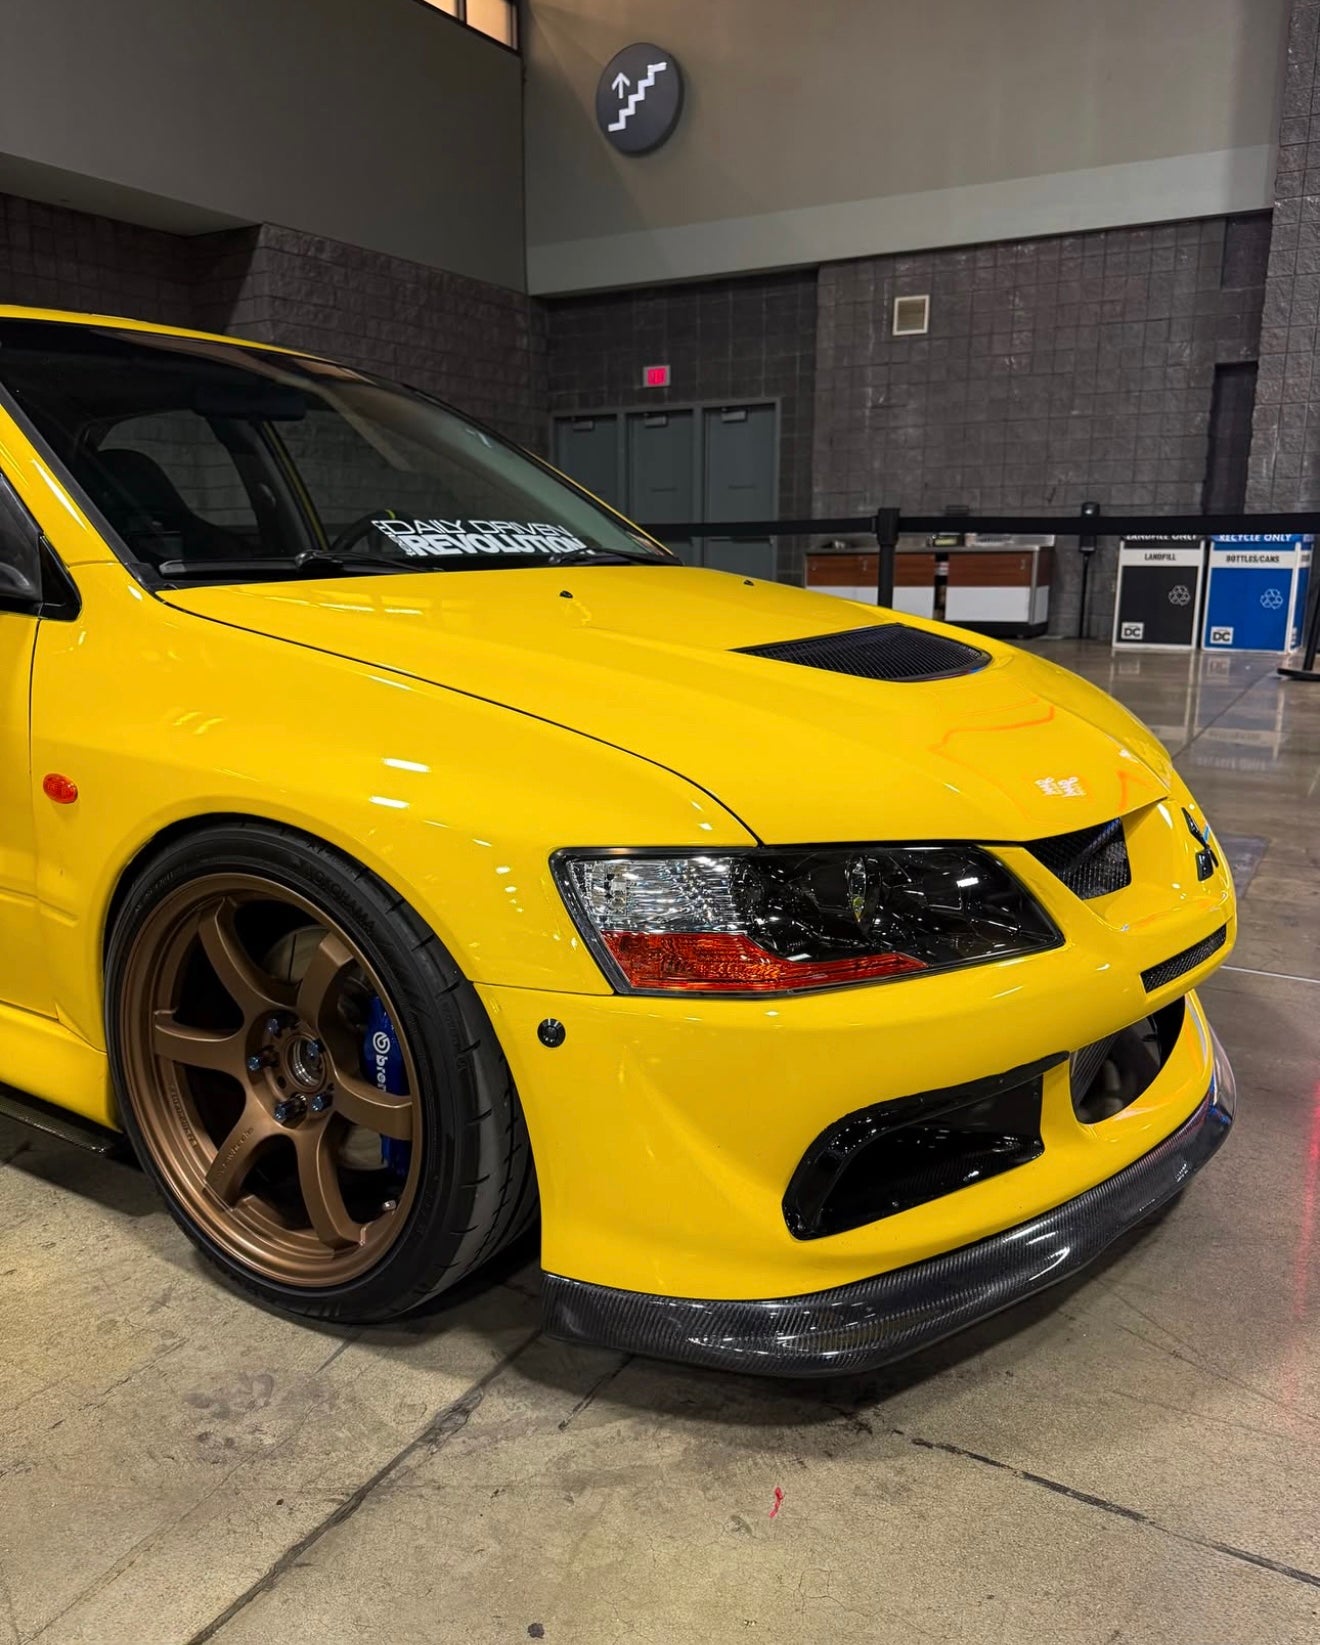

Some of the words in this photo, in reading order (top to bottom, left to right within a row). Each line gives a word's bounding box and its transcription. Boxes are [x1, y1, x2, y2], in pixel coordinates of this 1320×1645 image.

[380, 519, 467, 535] DAILY
[468, 519, 574, 538] DRIVEN
[399, 533, 590, 557] REVOLUTION
[1144, 553, 1177, 562] LANDFILL
[1225, 555, 1280, 563] BOTTLES/CANS
[1123, 627, 1141, 637] DC
[1212, 631, 1231, 642] DC
